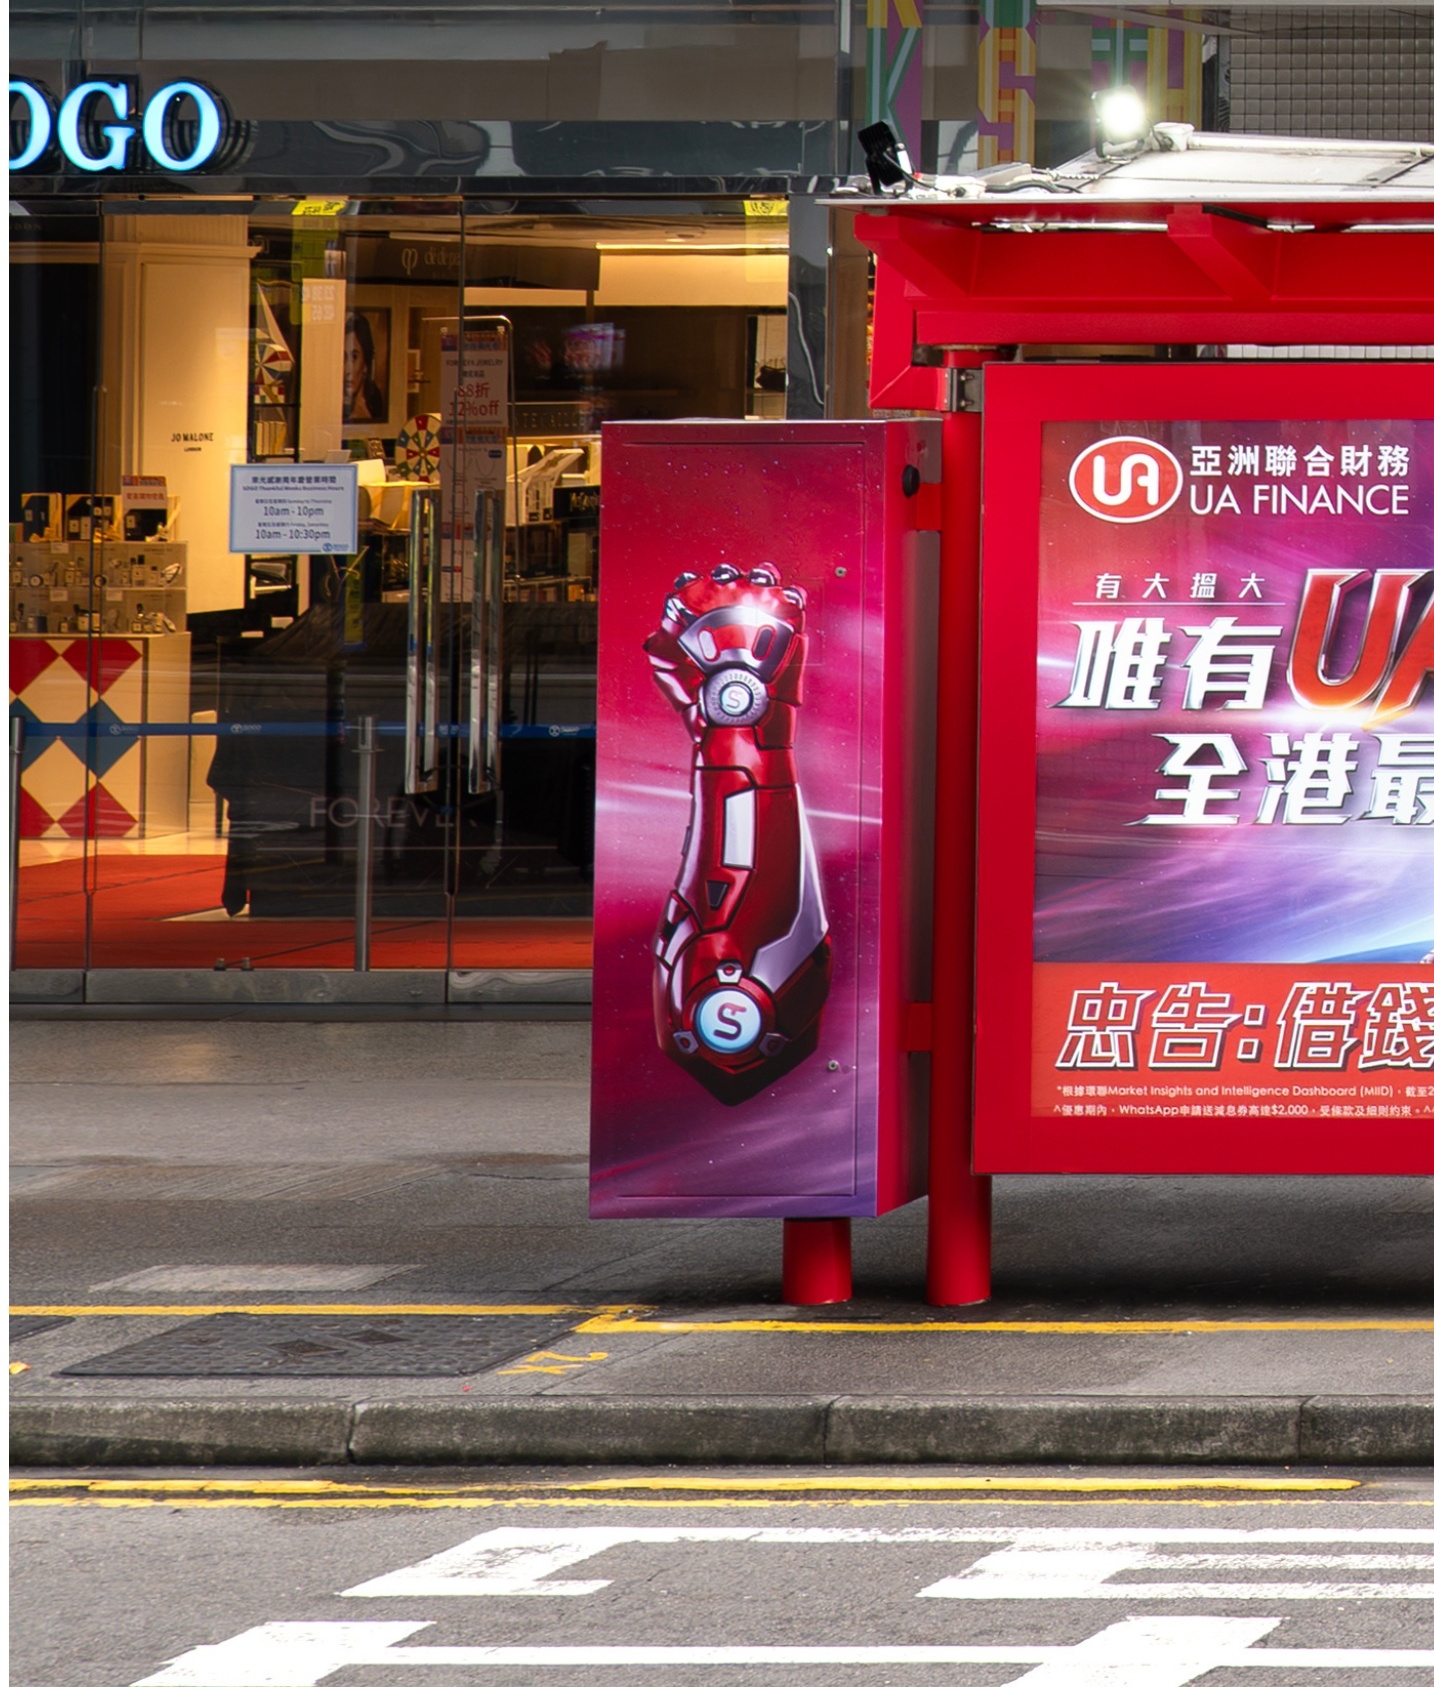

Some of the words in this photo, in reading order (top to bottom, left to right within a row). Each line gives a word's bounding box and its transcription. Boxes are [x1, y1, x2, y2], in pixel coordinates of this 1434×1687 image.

[183, 433, 214, 442] MALONE
[1190, 445, 1410, 478] 亞洲聯合財務
[1190, 484, 1241, 515] UA
[1254, 484, 1410, 515] FINANCE
[263, 506, 290, 516] 10am
[297, 506, 324, 518] 10pm
[255, 529, 282, 539] 10am
[289, 529, 331, 541] 10:30pm
[1150, 1085, 1192, 1098] Insights
[1195, 1086, 1218, 1096] and
[1221, 1085, 1289, 1098] Intelligence
[1292, 1085, 1356, 1097] Dashboard
